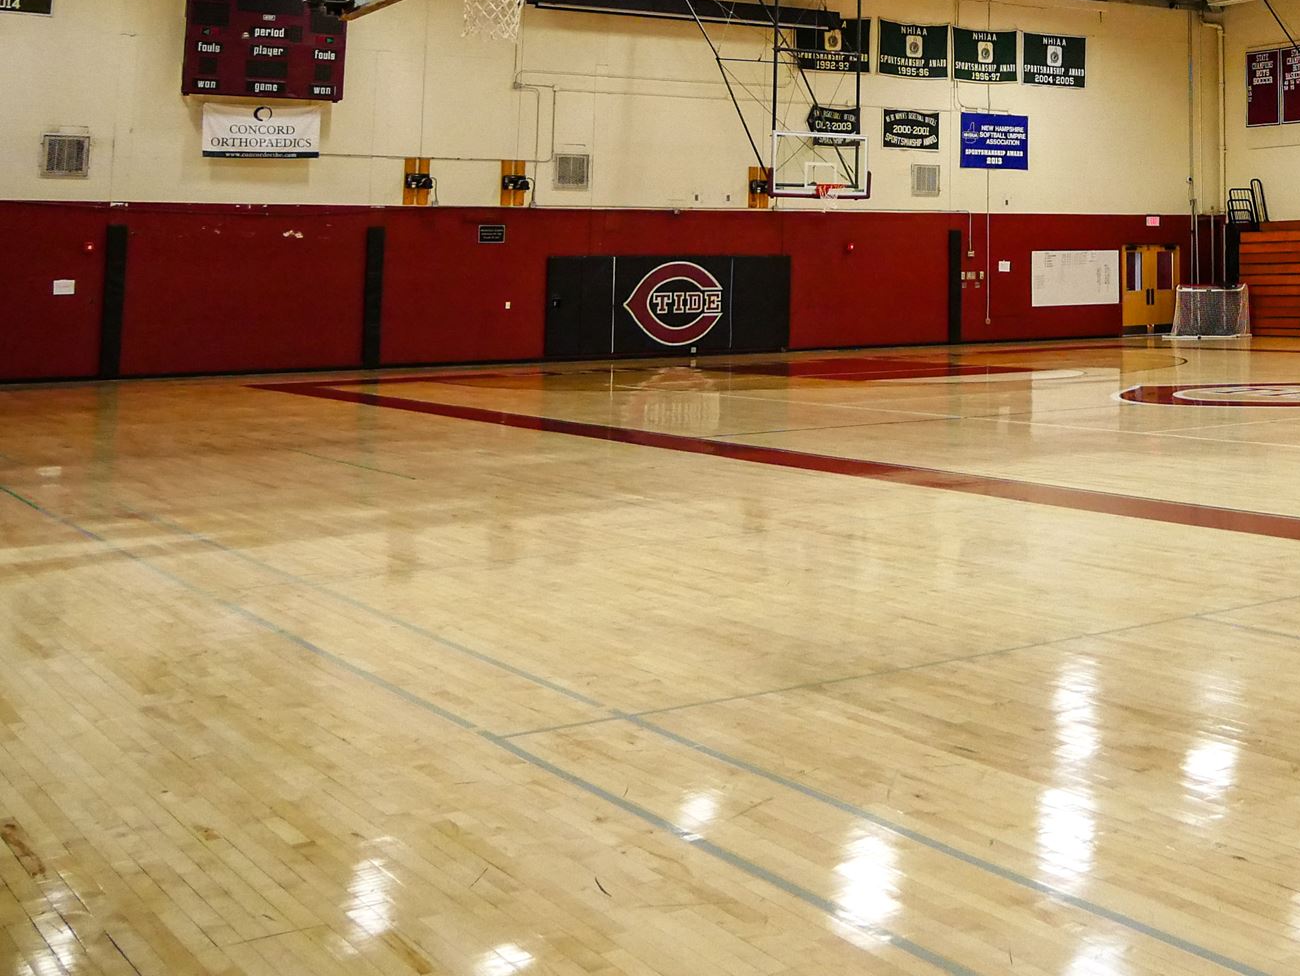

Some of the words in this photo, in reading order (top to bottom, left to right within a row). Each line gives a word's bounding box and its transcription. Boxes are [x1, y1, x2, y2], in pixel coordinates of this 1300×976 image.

[254, 27, 285, 38] period
[901, 26, 928, 36] NHIAA
[972, 32, 997, 41] NHIAA
[1042, 37, 1067, 46] NHIAA
[198, 42, 221, 53] fouls
[253, 45, 284, 56] player
[314, 49, 336, 60] fouls
[1256, 54, 1269, 62] STATE
[816, 61, 849, 71] 1992-93
[880, 55, 925, 67] SPORTSMANSHIP
[897, 67, 930, 76] 1995-96
[955, 61, 997, 72] SPORTSMANSHIP
[1024, 65, 1065, 75] SPORTSMANSHIP
[971, 72, 1001, 81] 1996-97
[1256, 69, 1270, 77] BOYS
[197, 80, 217, 89] won
[1034, 75, 1075, 85] 2004-2005
[1253, 76, 1273, 85] SOCCER
[254, 83, 278, 92] game
[313, 86, 331, 95] won
[229, 124, 295, 135] CONCORD
[893, 125, 930, 136] 2000-2001
[210, 137, 312, 148] ORTHOPAEDICS
[986, 157, 1003, 165] 2013
[653, 291, 722, 314] TIDE
